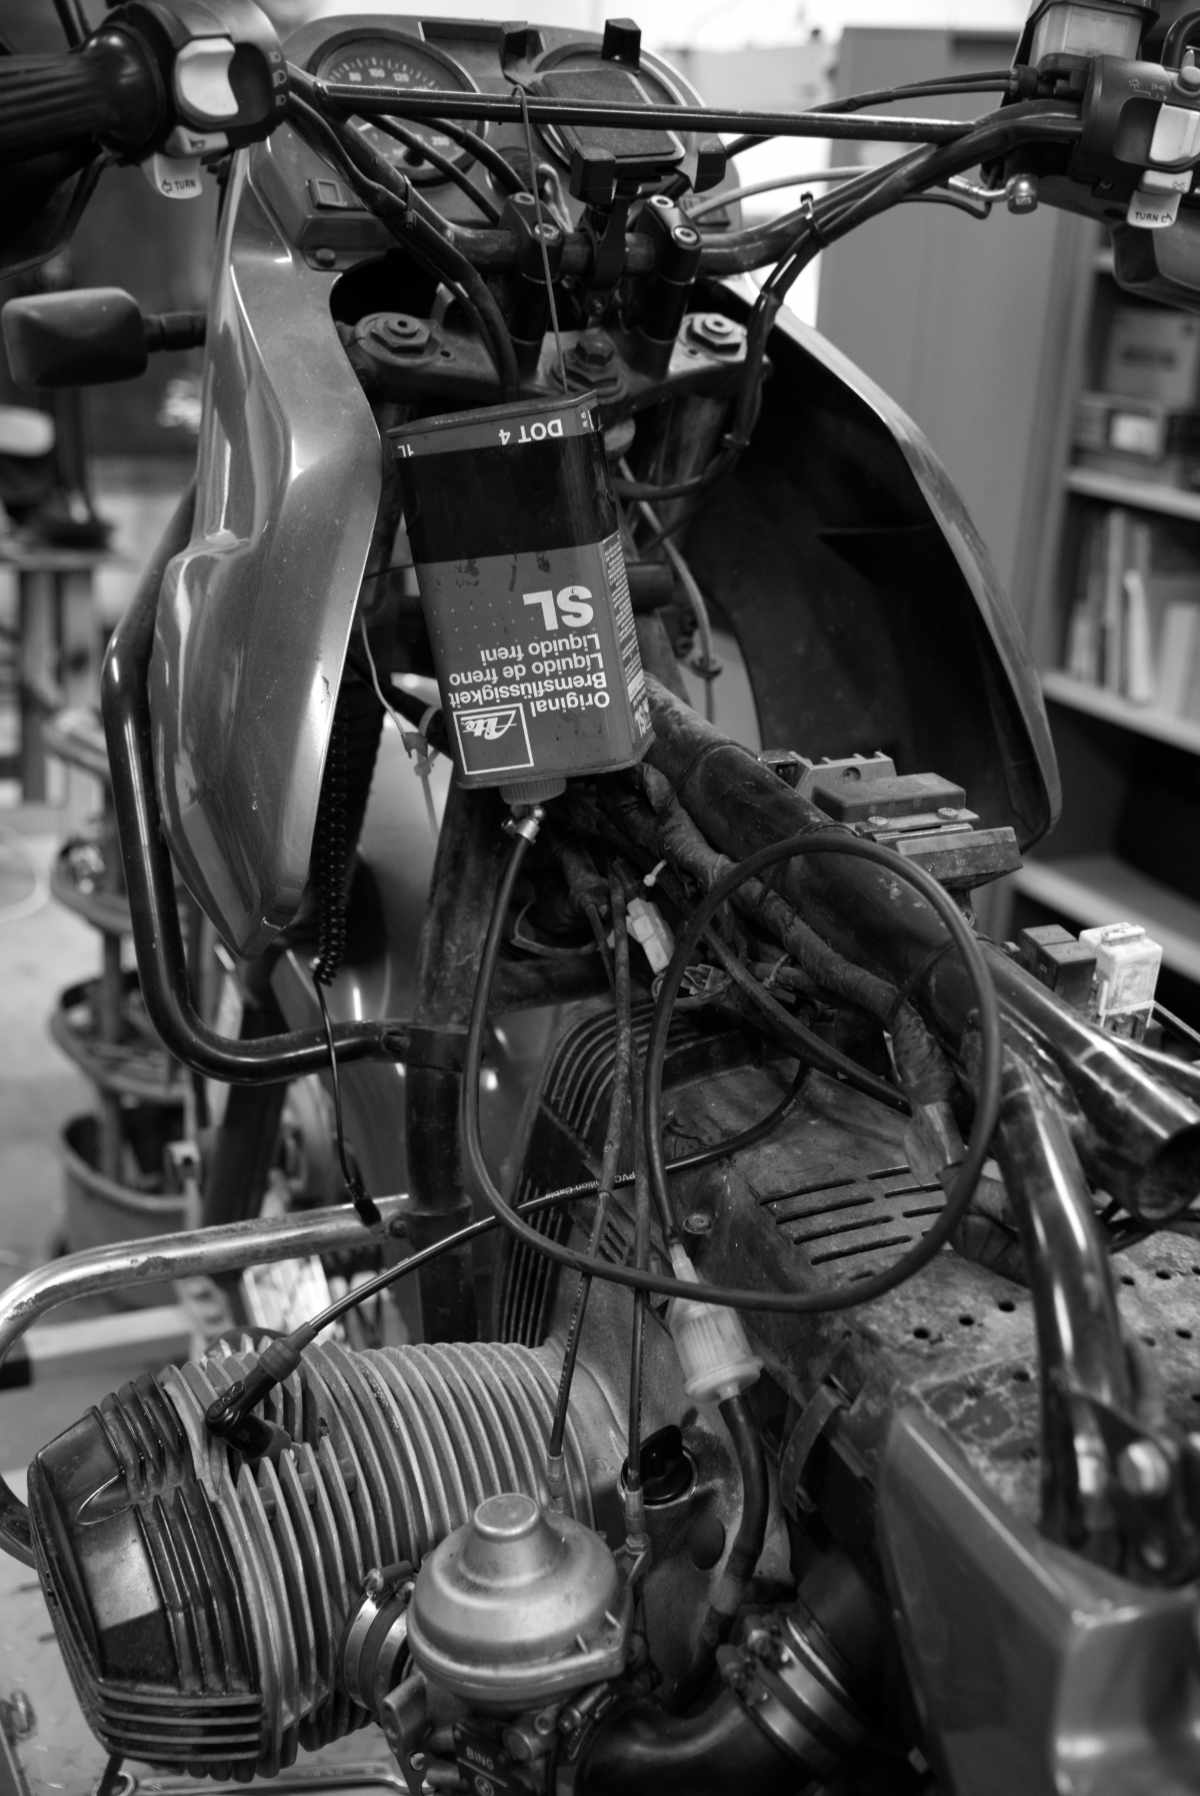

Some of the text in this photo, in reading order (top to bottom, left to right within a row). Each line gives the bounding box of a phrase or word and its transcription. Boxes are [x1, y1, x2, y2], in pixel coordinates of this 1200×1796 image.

[174, 179, 196, 192] TURN
[1135, 211, 1159, 222] TURN
[498, 429, 511, 446] 4
[517, 418, 563, 443] DOT
[397, 444, 414, 457] 1L
[523, 585, 593, 629] SL
[480, 633, 600, 665] Liquido freni
[448, 653, 604, 686] Líquido de freno
[448, 671, 607, 708] Bremsflüssigkeit
[530, 691, 610, 717] Original
[460, 709, 517, 740] Ate
[465, 1745, 494, 1771] BING
